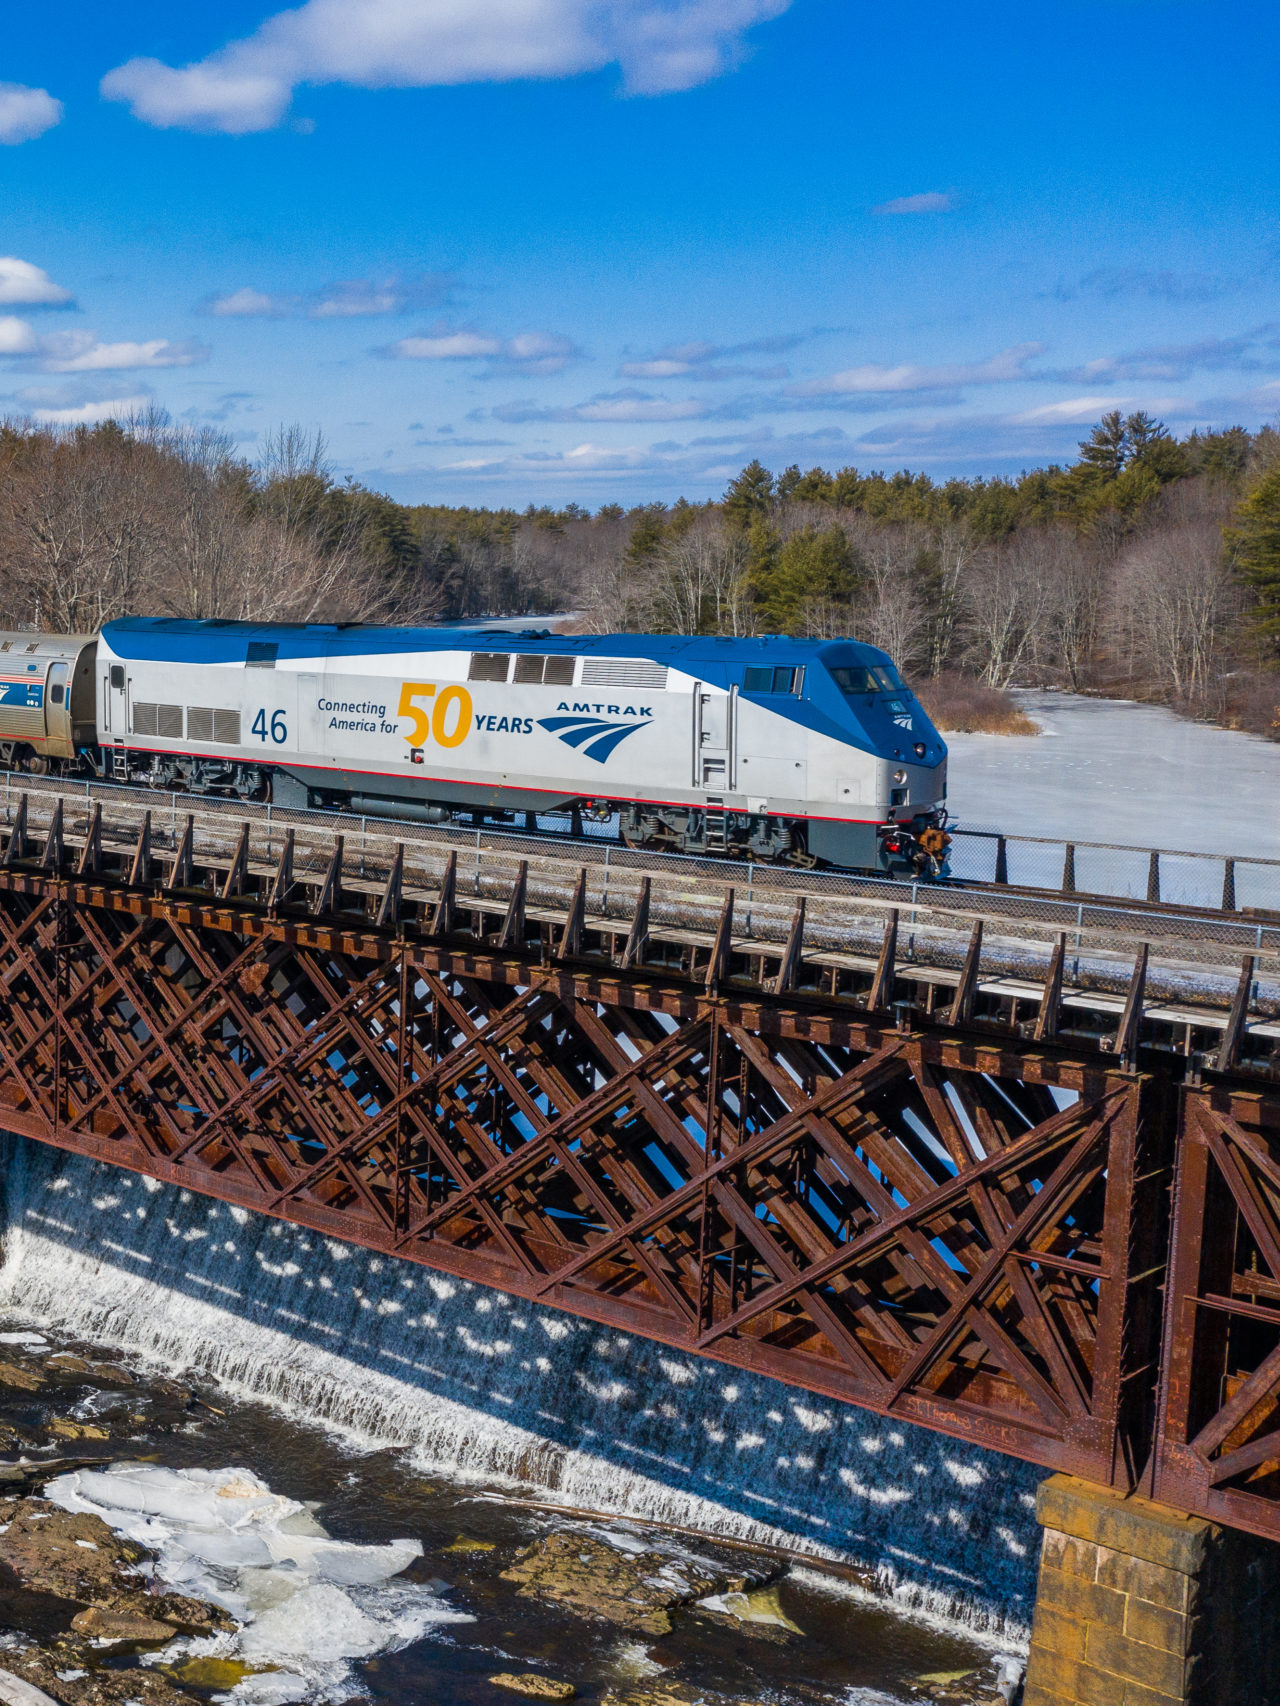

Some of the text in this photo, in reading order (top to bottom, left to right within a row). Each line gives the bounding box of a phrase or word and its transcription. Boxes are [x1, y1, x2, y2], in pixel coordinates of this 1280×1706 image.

[317, 698, 386, 717] Connecting
[397, 682, 533, 748] 50 YEARS
[556, 702, 654, 717] AMTRAK
[251, 708, 287, 744] 46
[328, 716, 399, 734] America for
